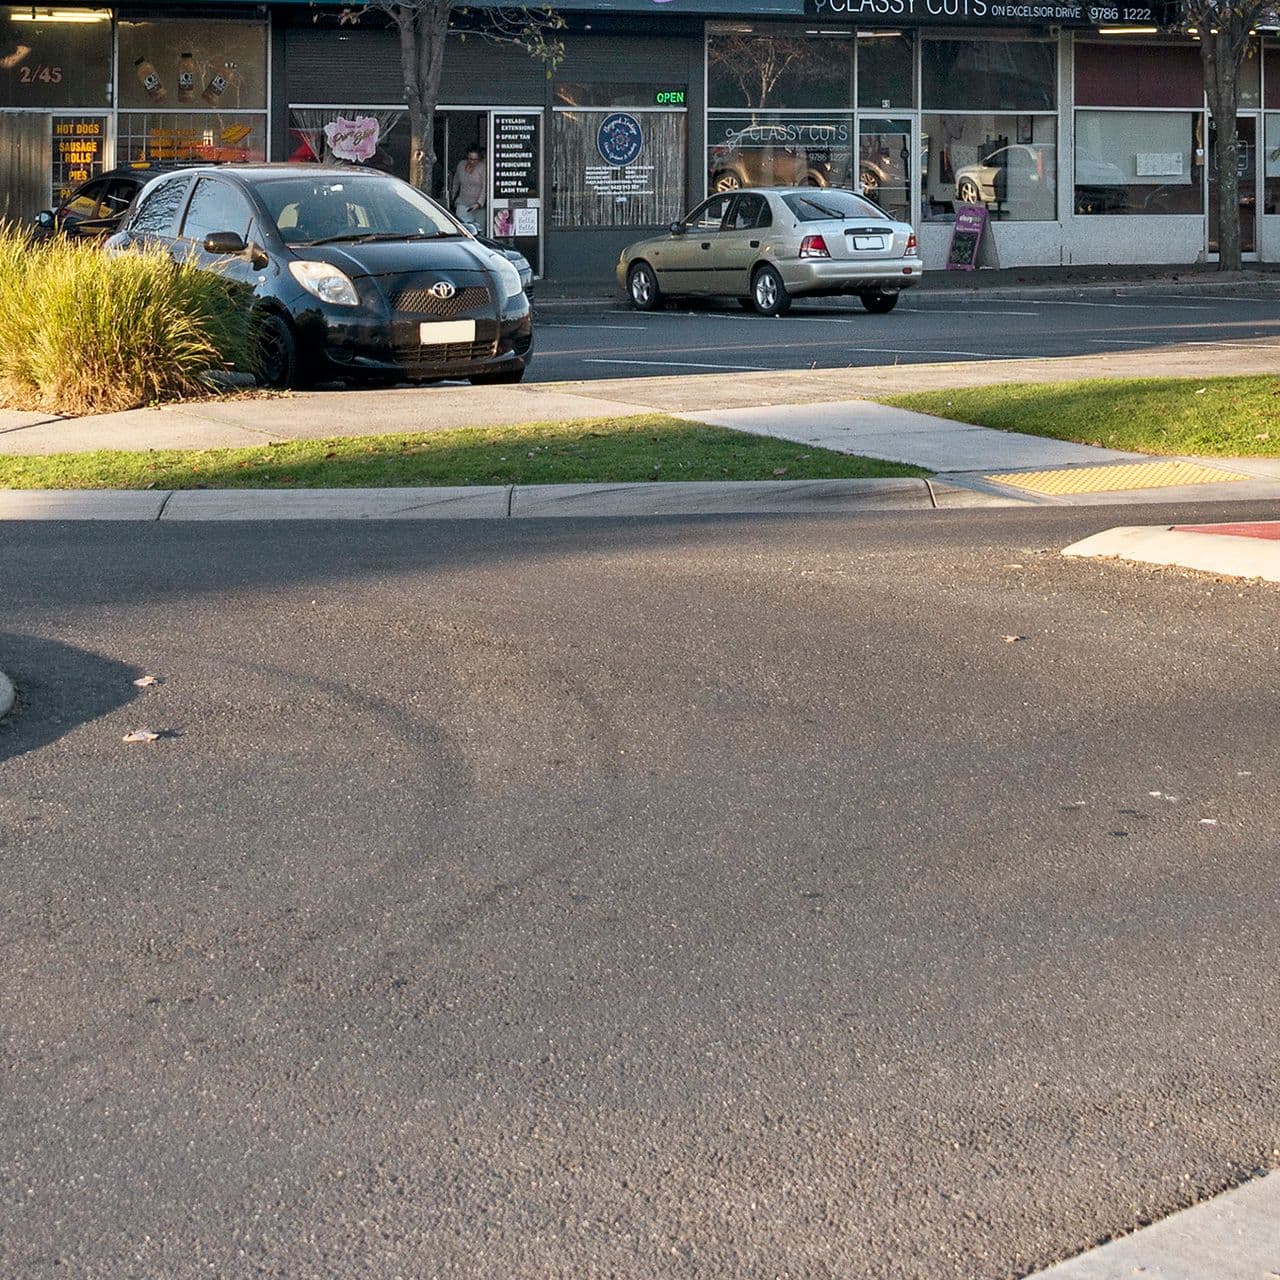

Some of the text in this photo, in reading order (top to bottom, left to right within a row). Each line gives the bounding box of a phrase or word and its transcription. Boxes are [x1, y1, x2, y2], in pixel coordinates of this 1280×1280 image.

[991, 5, 1006, 17] ON
[1006, 6, 1054, 18] EXCELSIOR
[1055, 7, 1081, 19] DRIVE
[1090, 8, 1118, 20] 9786
[1123, 8, 1152, 20] 1222
[20, 66, 63, 84] 2/45
[656, 92, 684, 103] OPEN
[57, 124, 100, 134] HOT DOGS
[749, 124, 848, 141] CLASSY CUTS
[59, 141, 97, 152] SAUSAGE
[65, 152, 91, 163] ROLLS
[68, 170, 88, 180] PIES
